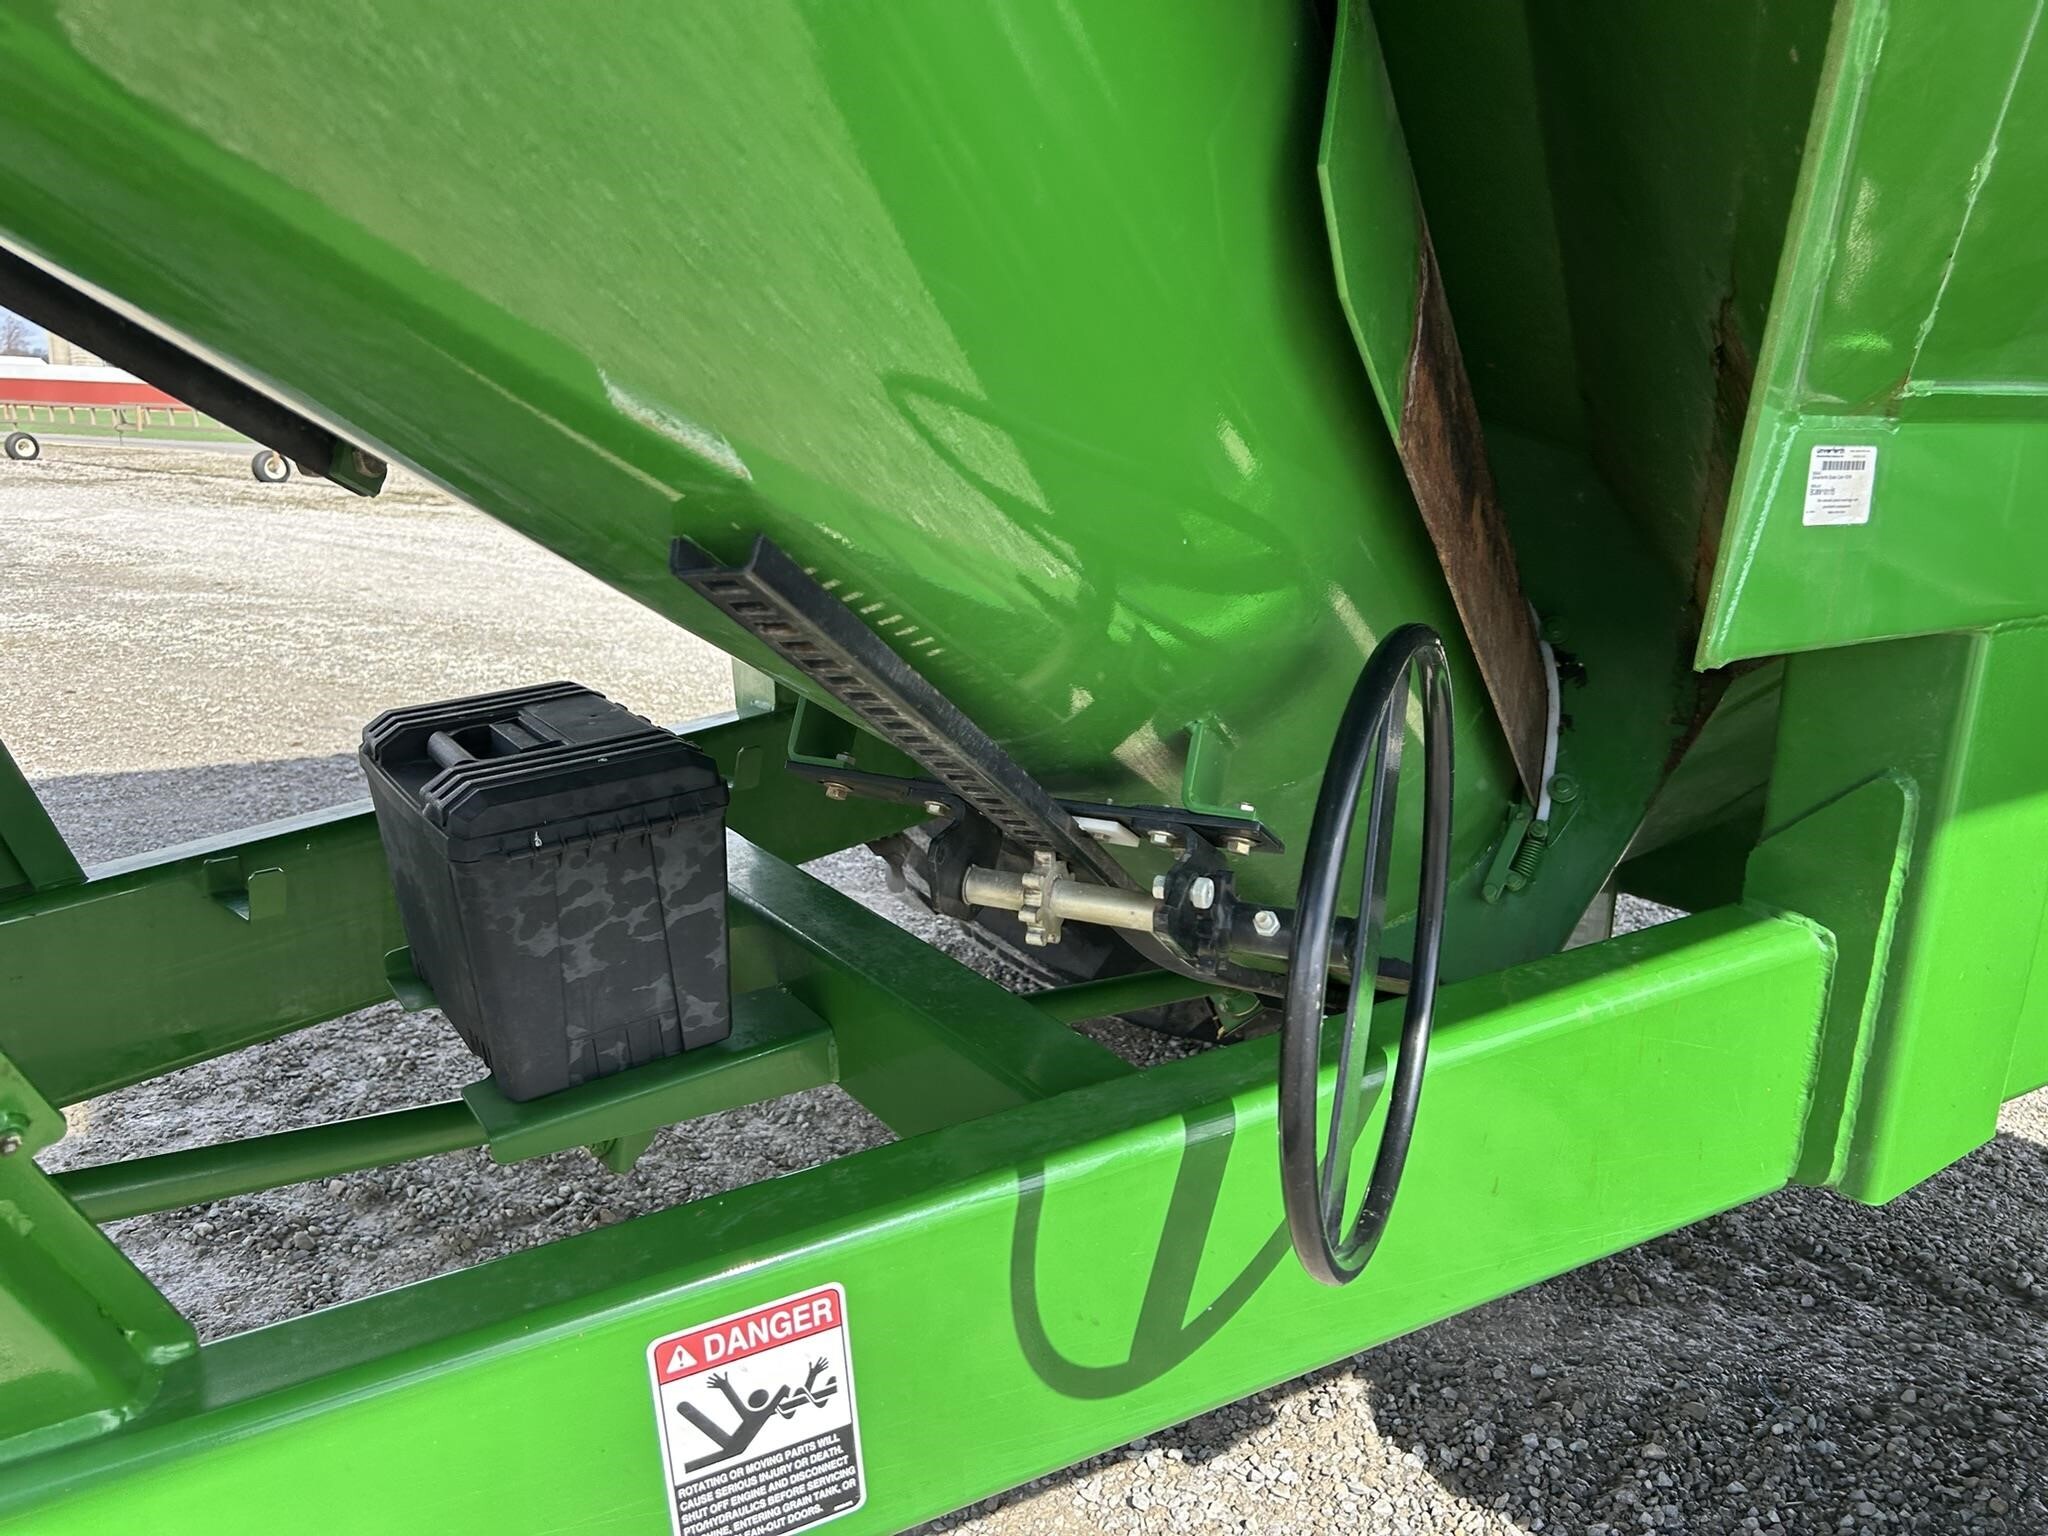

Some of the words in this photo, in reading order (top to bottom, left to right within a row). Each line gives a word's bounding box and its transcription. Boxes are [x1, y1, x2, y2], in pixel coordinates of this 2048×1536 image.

[703, 1297, 833, 1362] DANGER
[678, 1473, 728, 1499] ROTATING
[729, 1467, 744, 1480] OR
[745, 1453, 783, 1474] MOVING
[784, 1441, 816, 1460] PARTS
[817, 1433, 840, 1448] WILL
[680, 1491, 714, 1511] CAUSE
[715, 1476, 758, 1498] SERIOUS
[759, 1462, 793, 1483] INJURY
[794, 1457, 809, 1470] OR
[810, 1445, 844, 1464] DEATH.
[681, 1506, 708, 1525] SHUT
[709, 1499, 730, 1514] OFF
[730, 1485, 767, 1506] ENGINE
[768, 1477, 788, 1493] AND
[789, 1455, 849, 1484] DISCONNECT
[683, 1498, 766, 1536] PTO/HYDRAULICS
[767, 1484, 806, 1505] BEFORE
[806, 1465, 856, 1491] SERVICING
[733, 1506, 781, 1531] ENTERING
[782, 1494, 813, 1513] GRAIN
[842, 1477, 857, 1491] OR
[787, 1503, 824, 1524] DOORS.
